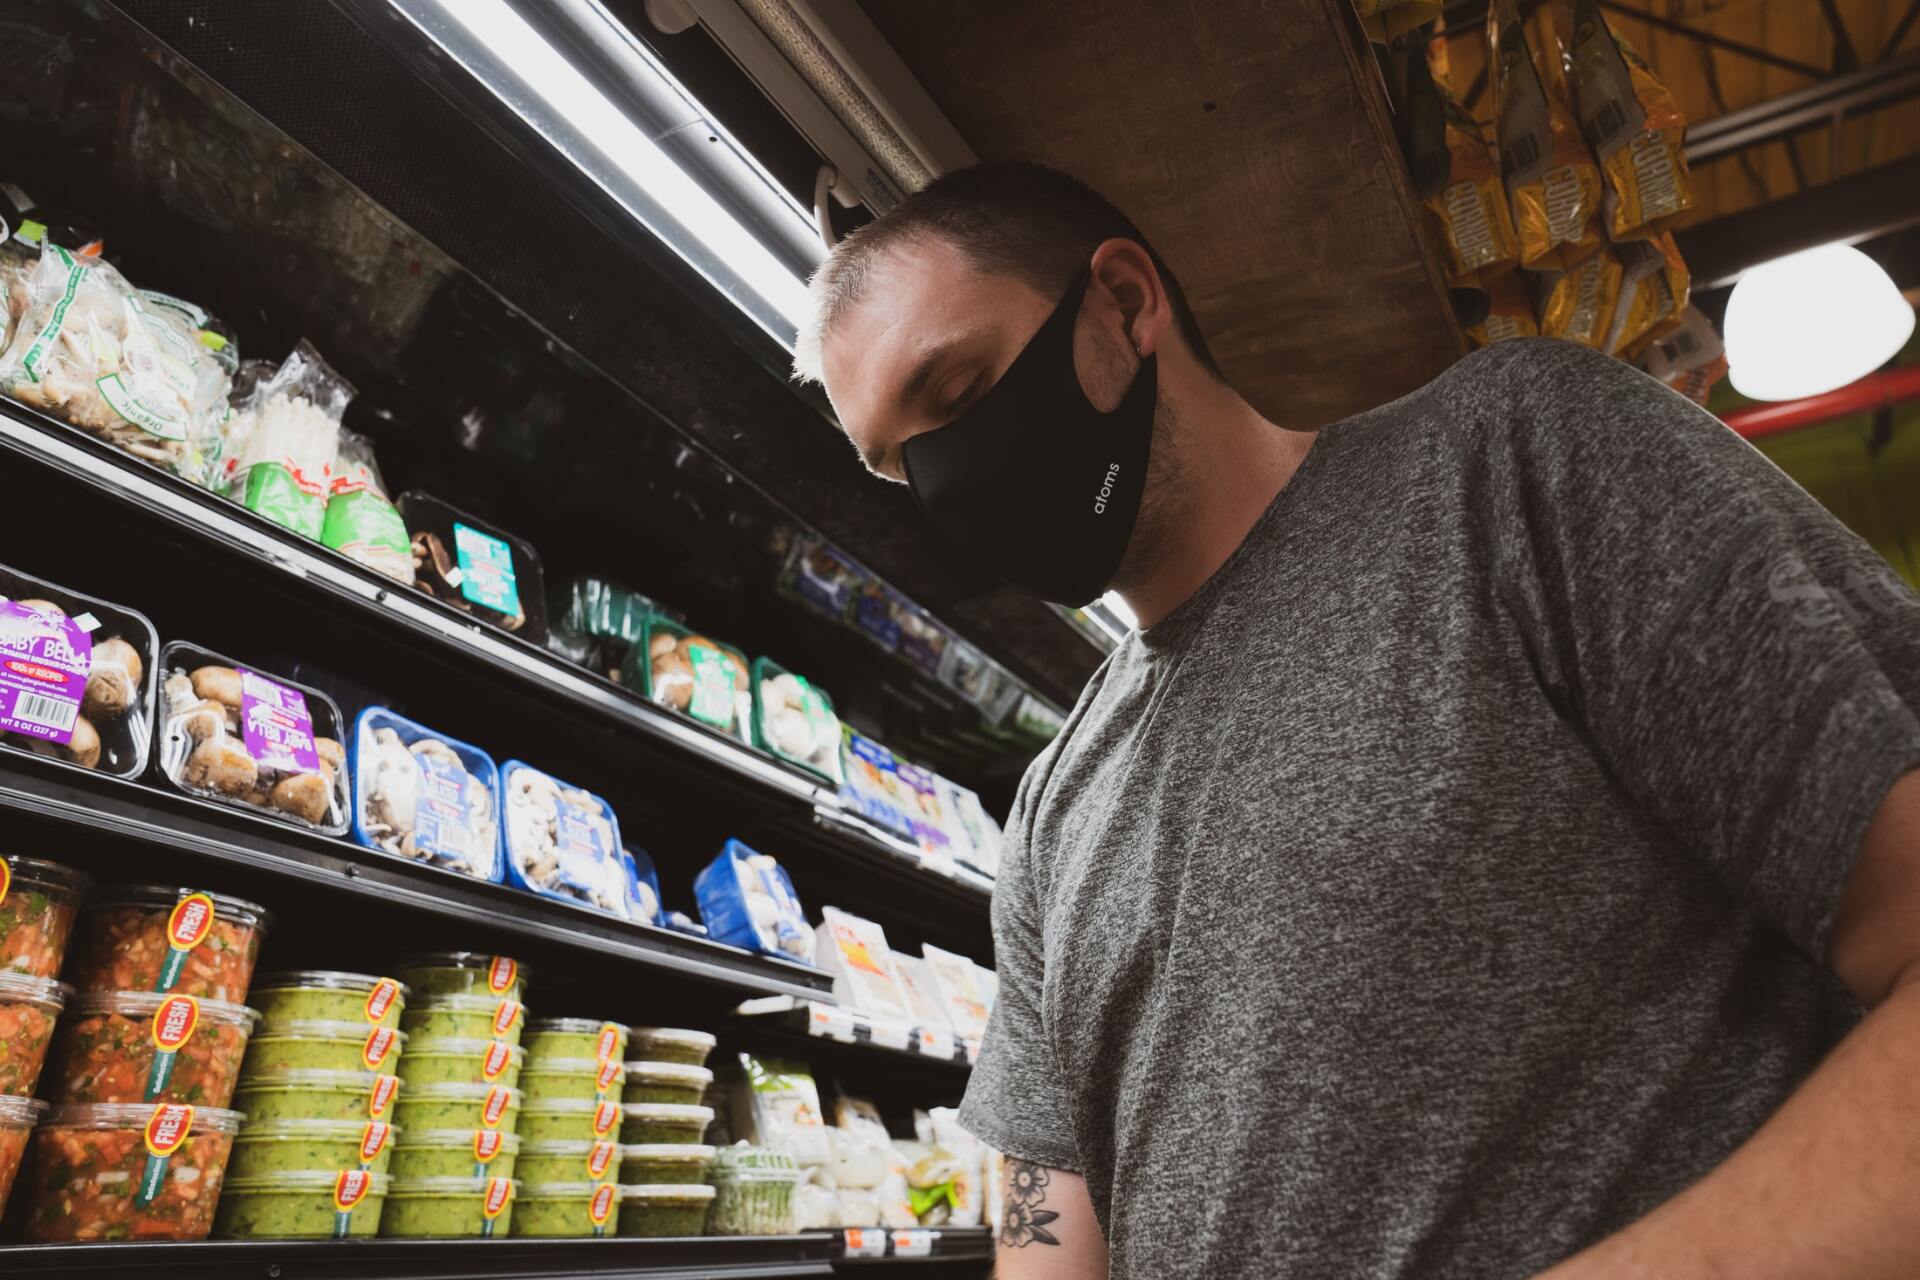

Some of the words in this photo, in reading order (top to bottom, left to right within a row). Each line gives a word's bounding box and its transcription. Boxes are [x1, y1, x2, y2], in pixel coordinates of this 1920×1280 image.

[121, 401, 163, 431] Organic
[1094, 463, 1120, 514] atoms
[176, 902, 207, 940] FRESH
[161, 1001, 191, 1041] FRESH
[154, 1105, 187, 1145] FRESH
